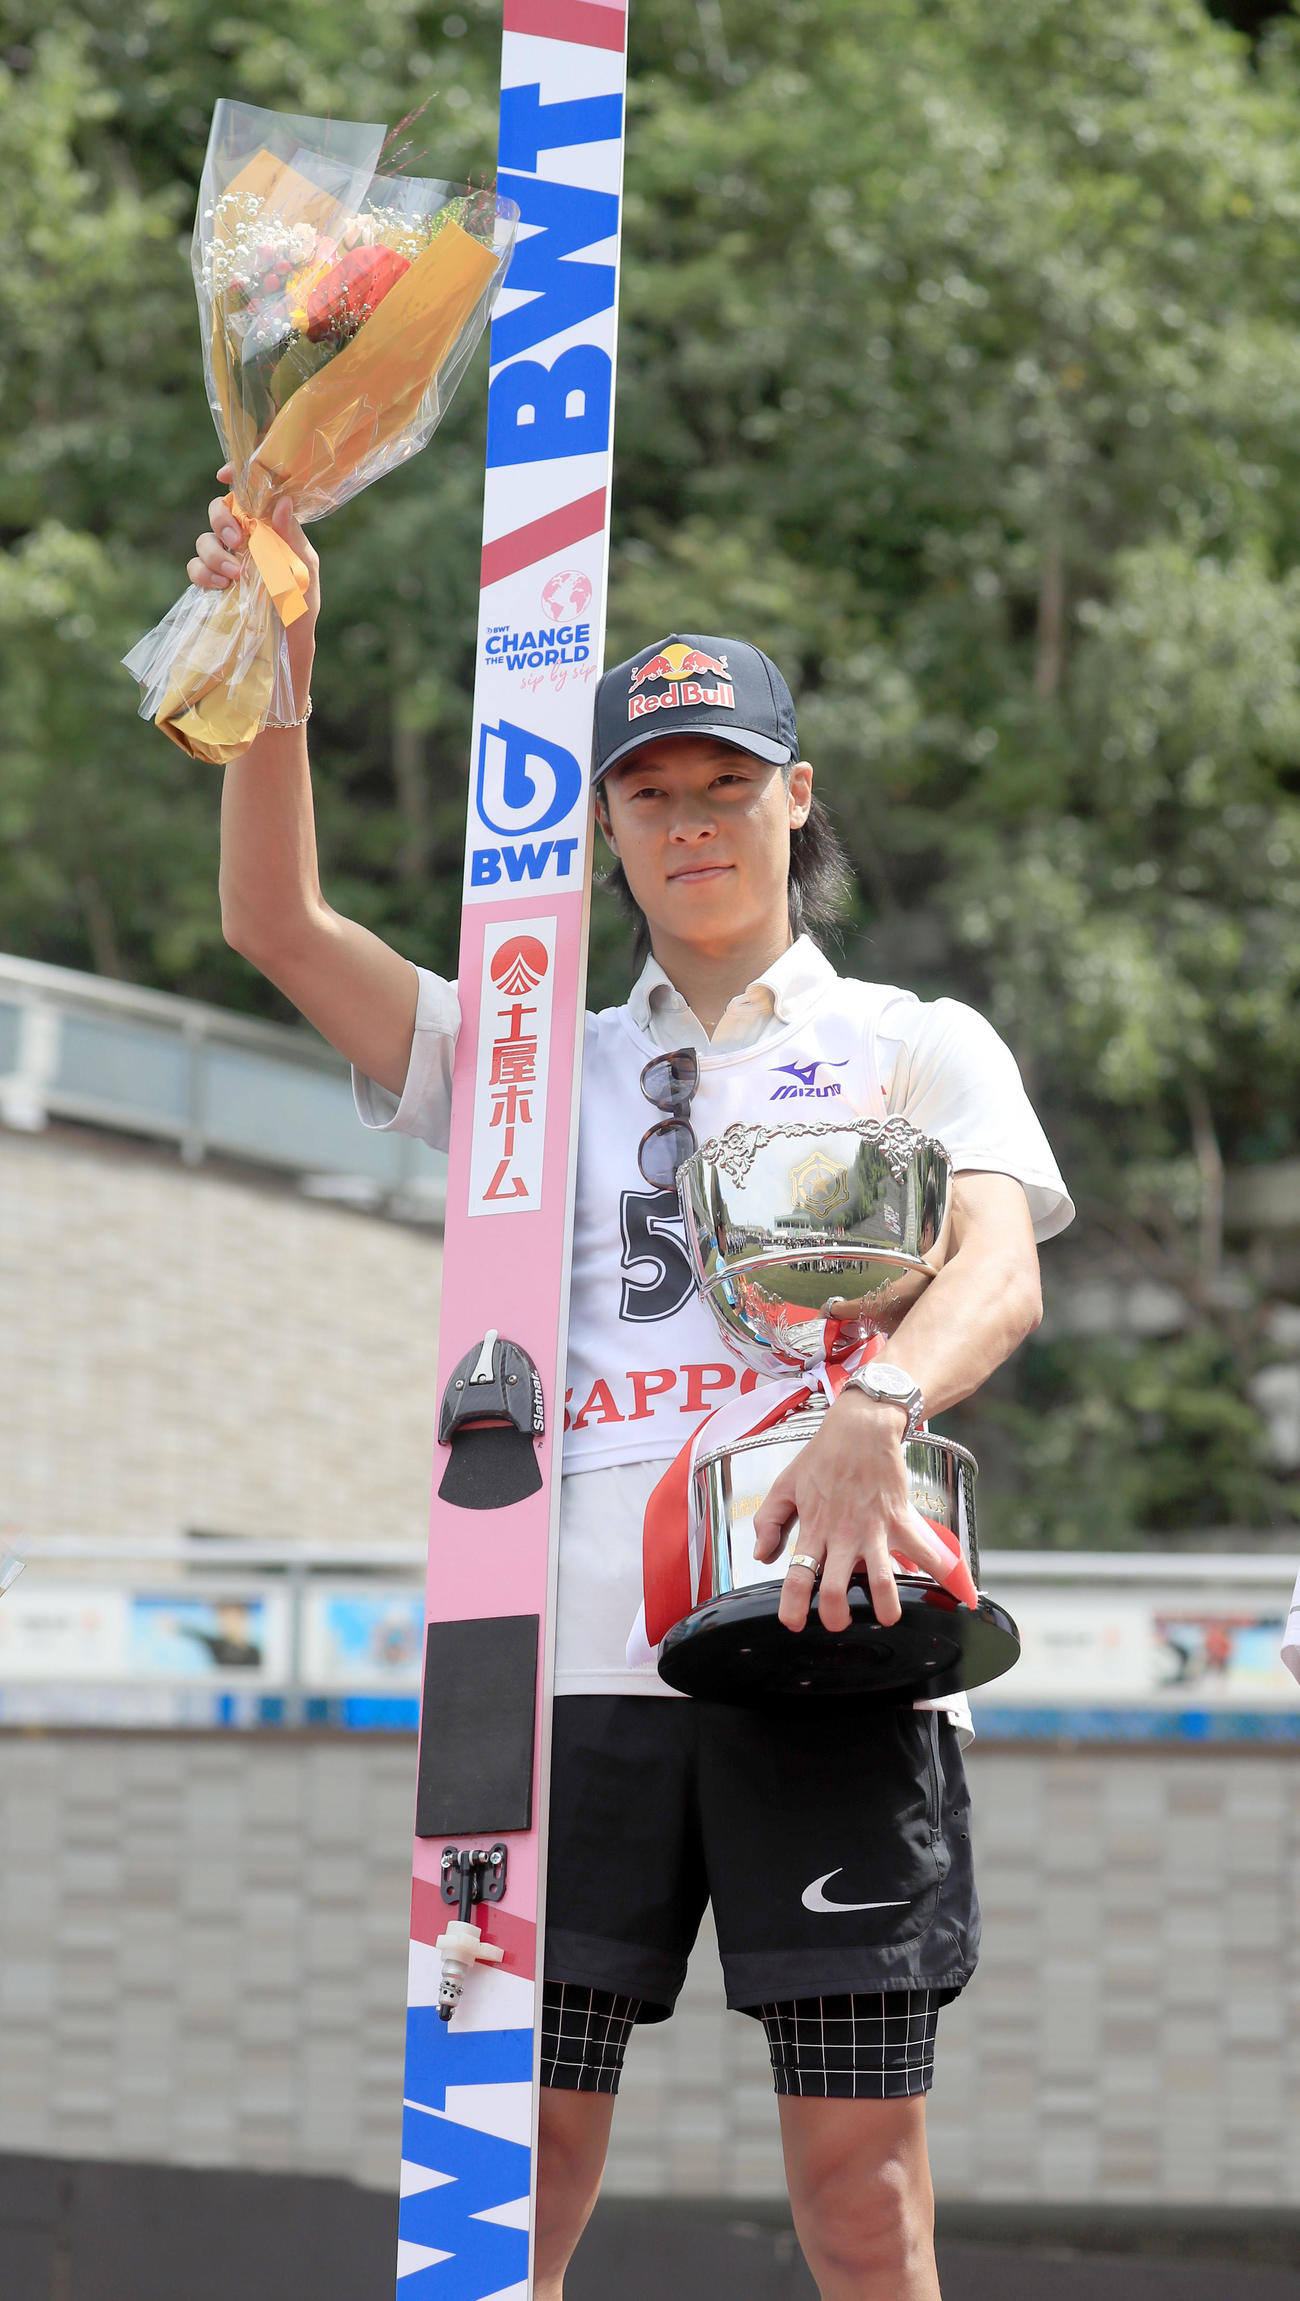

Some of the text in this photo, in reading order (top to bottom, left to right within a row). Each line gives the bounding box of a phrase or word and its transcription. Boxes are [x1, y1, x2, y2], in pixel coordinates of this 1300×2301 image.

[486, 82, 623, 468] BWT
[485, 623, 590, 654] CHANGE
[493, 625, 510, 633] BWT
[485, 645, 590, 671] THE WORLD
[519, 658, 598, 693] sip by sip
[628, 681, 735, 720] Red Bull
[470, 838, 578, 887] BWT
[482, 1003, 538, 1200] 土屋ホーム
